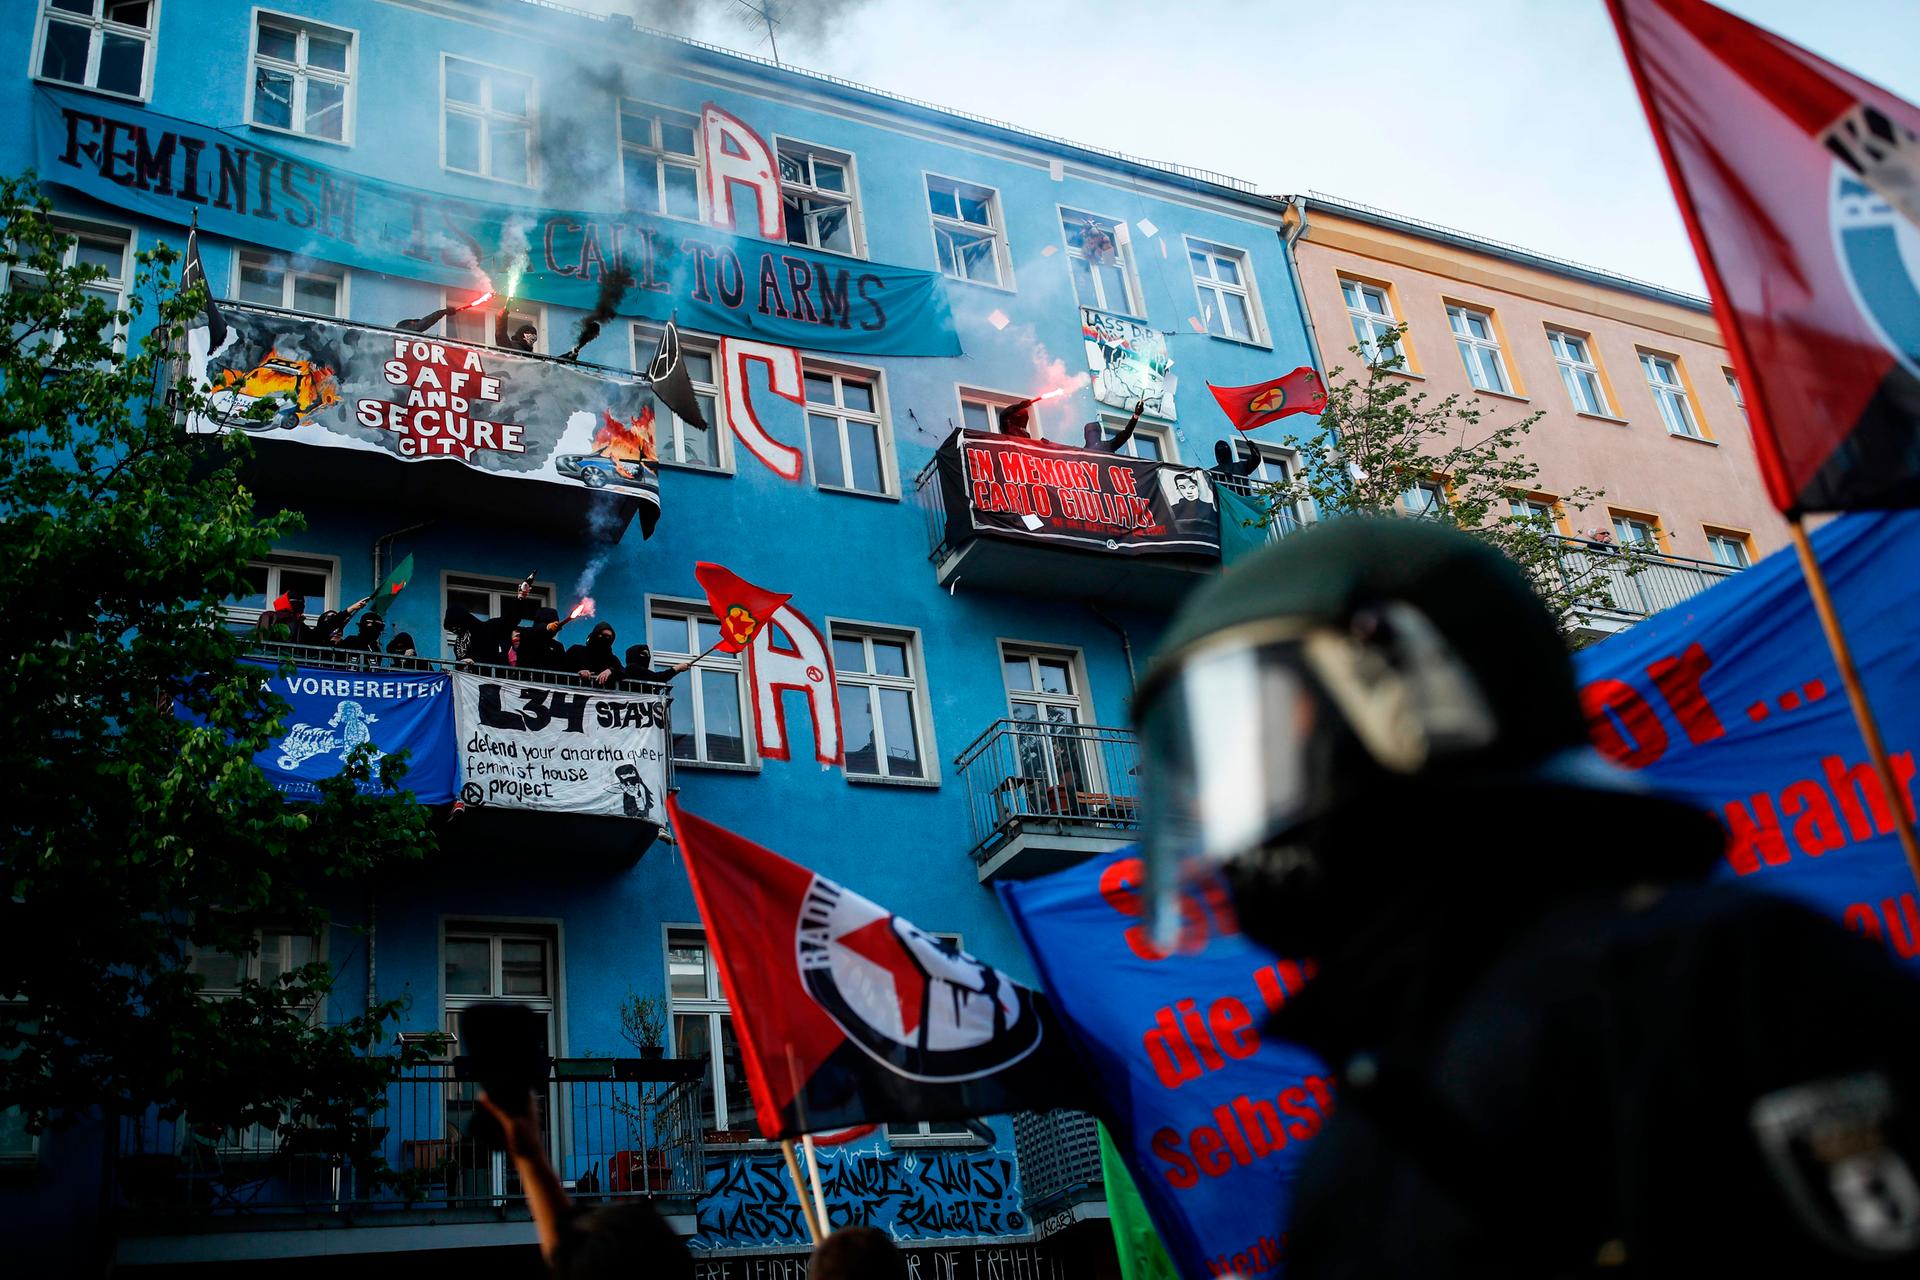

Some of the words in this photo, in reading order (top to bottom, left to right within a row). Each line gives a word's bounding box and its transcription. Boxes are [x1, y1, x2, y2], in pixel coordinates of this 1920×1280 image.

[58, 108, 360, 245] FEMINISM
[544, 219, 670, 294] CALL
[681, 239, 745, 308] TO
[758, 253, 887, 331] ARMS
[394, 340, 448, 366] FOR
[463, 351, 483, 373] A
[384, 361, 501, 401] SAFE
[407, 389, 470, 414] AND
[356, 399, 526, 453] SECURE
[399, 438, 476, 462] CITY
[966, 448, 996, 483] IN
[998, 451, 1101, 493] MEMORY
[1108, 465, 1137, 497] OF
[972, 481, 1053, 519] CARLO
[286, 676, 444, 699] VORBEREITEN
[477, 683, 594, 734] L34
[595, 701, 665, 730] STAYS
[467, 731, 518, 759] defend
[522, 745, 556, 761] your
[561, 744, 624, 762] anarcha
[627, 748, 665, 766] queer
[466, 756, 536, 780] feminist
[541, 764, 589, 781] house
[489, 779, 555, 802] project
[1141, 996, 1262, 1089] die
